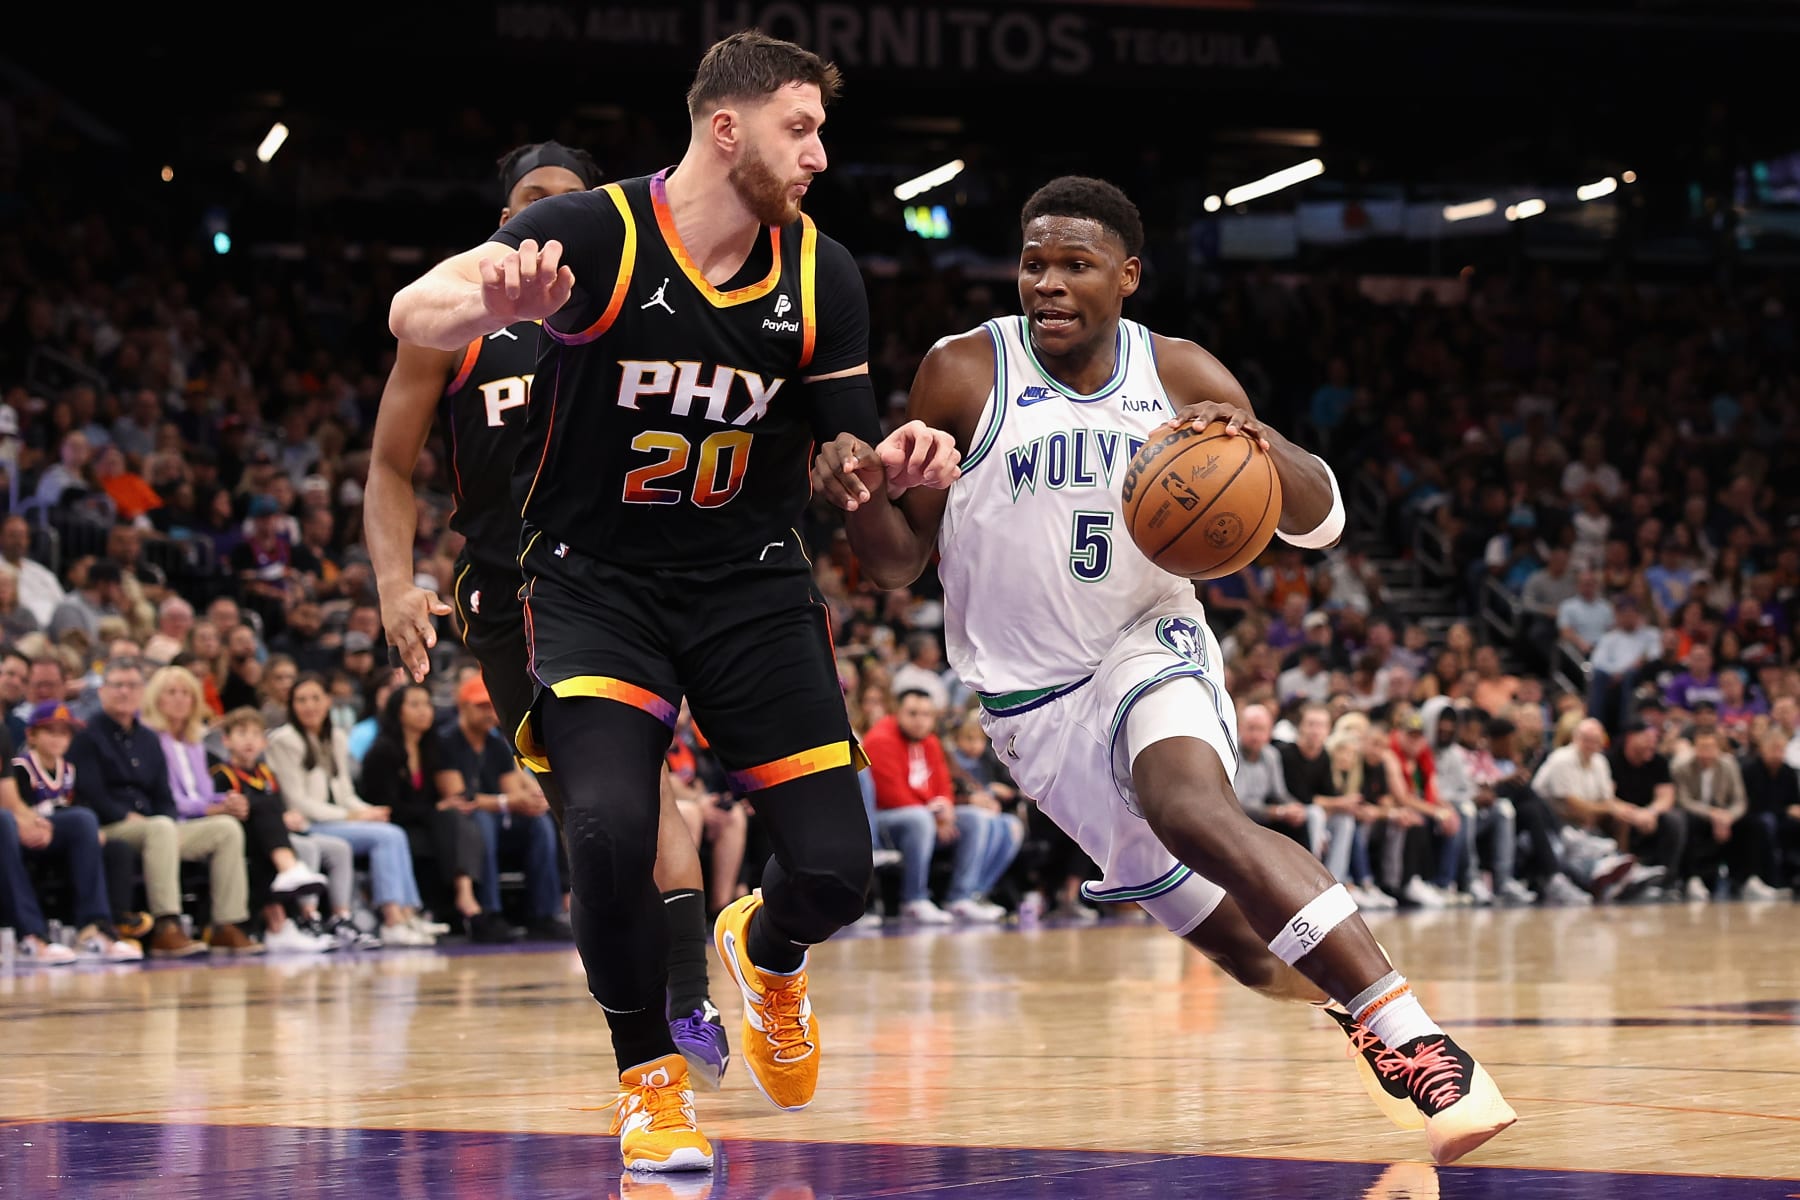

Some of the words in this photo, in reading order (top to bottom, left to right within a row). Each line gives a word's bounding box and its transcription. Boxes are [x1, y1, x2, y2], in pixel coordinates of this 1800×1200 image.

[584, 8, 682, 46] AGAVE
[702, 1, 1091, 73] HORNITOS
[1109, 28, 1281, 68] TEQUILA
[762, 319, 799, 332] PayPal
[478, 374, 535, 427] P
[617, 360, 786, 425] PHX
[1023, 386, 1050, 399] NIKE
[622, 430, 754, 508] 20
[1069, 510, 1114, 583] 5
[1292, 916, 1310, 937] 5
[1300, 925, 1324, 951] AE
